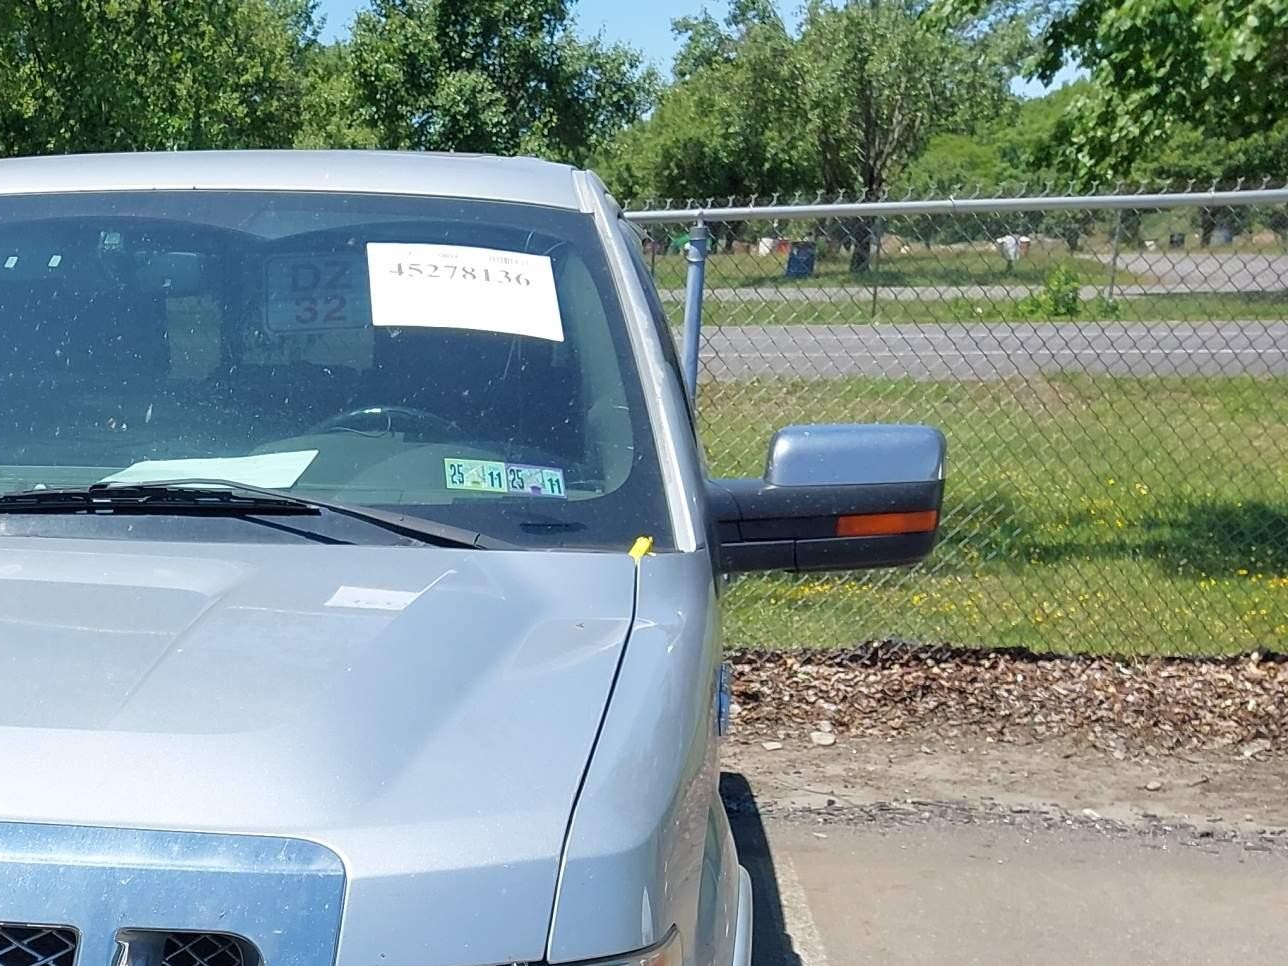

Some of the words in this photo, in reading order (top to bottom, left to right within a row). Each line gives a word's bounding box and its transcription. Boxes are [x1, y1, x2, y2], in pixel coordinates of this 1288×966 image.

[389, 262, 531, 287] 45278136
[295, 295, 347, 324] 32
[450, 463, 464, 484] 25
[509, 468, 524, 490] 25
